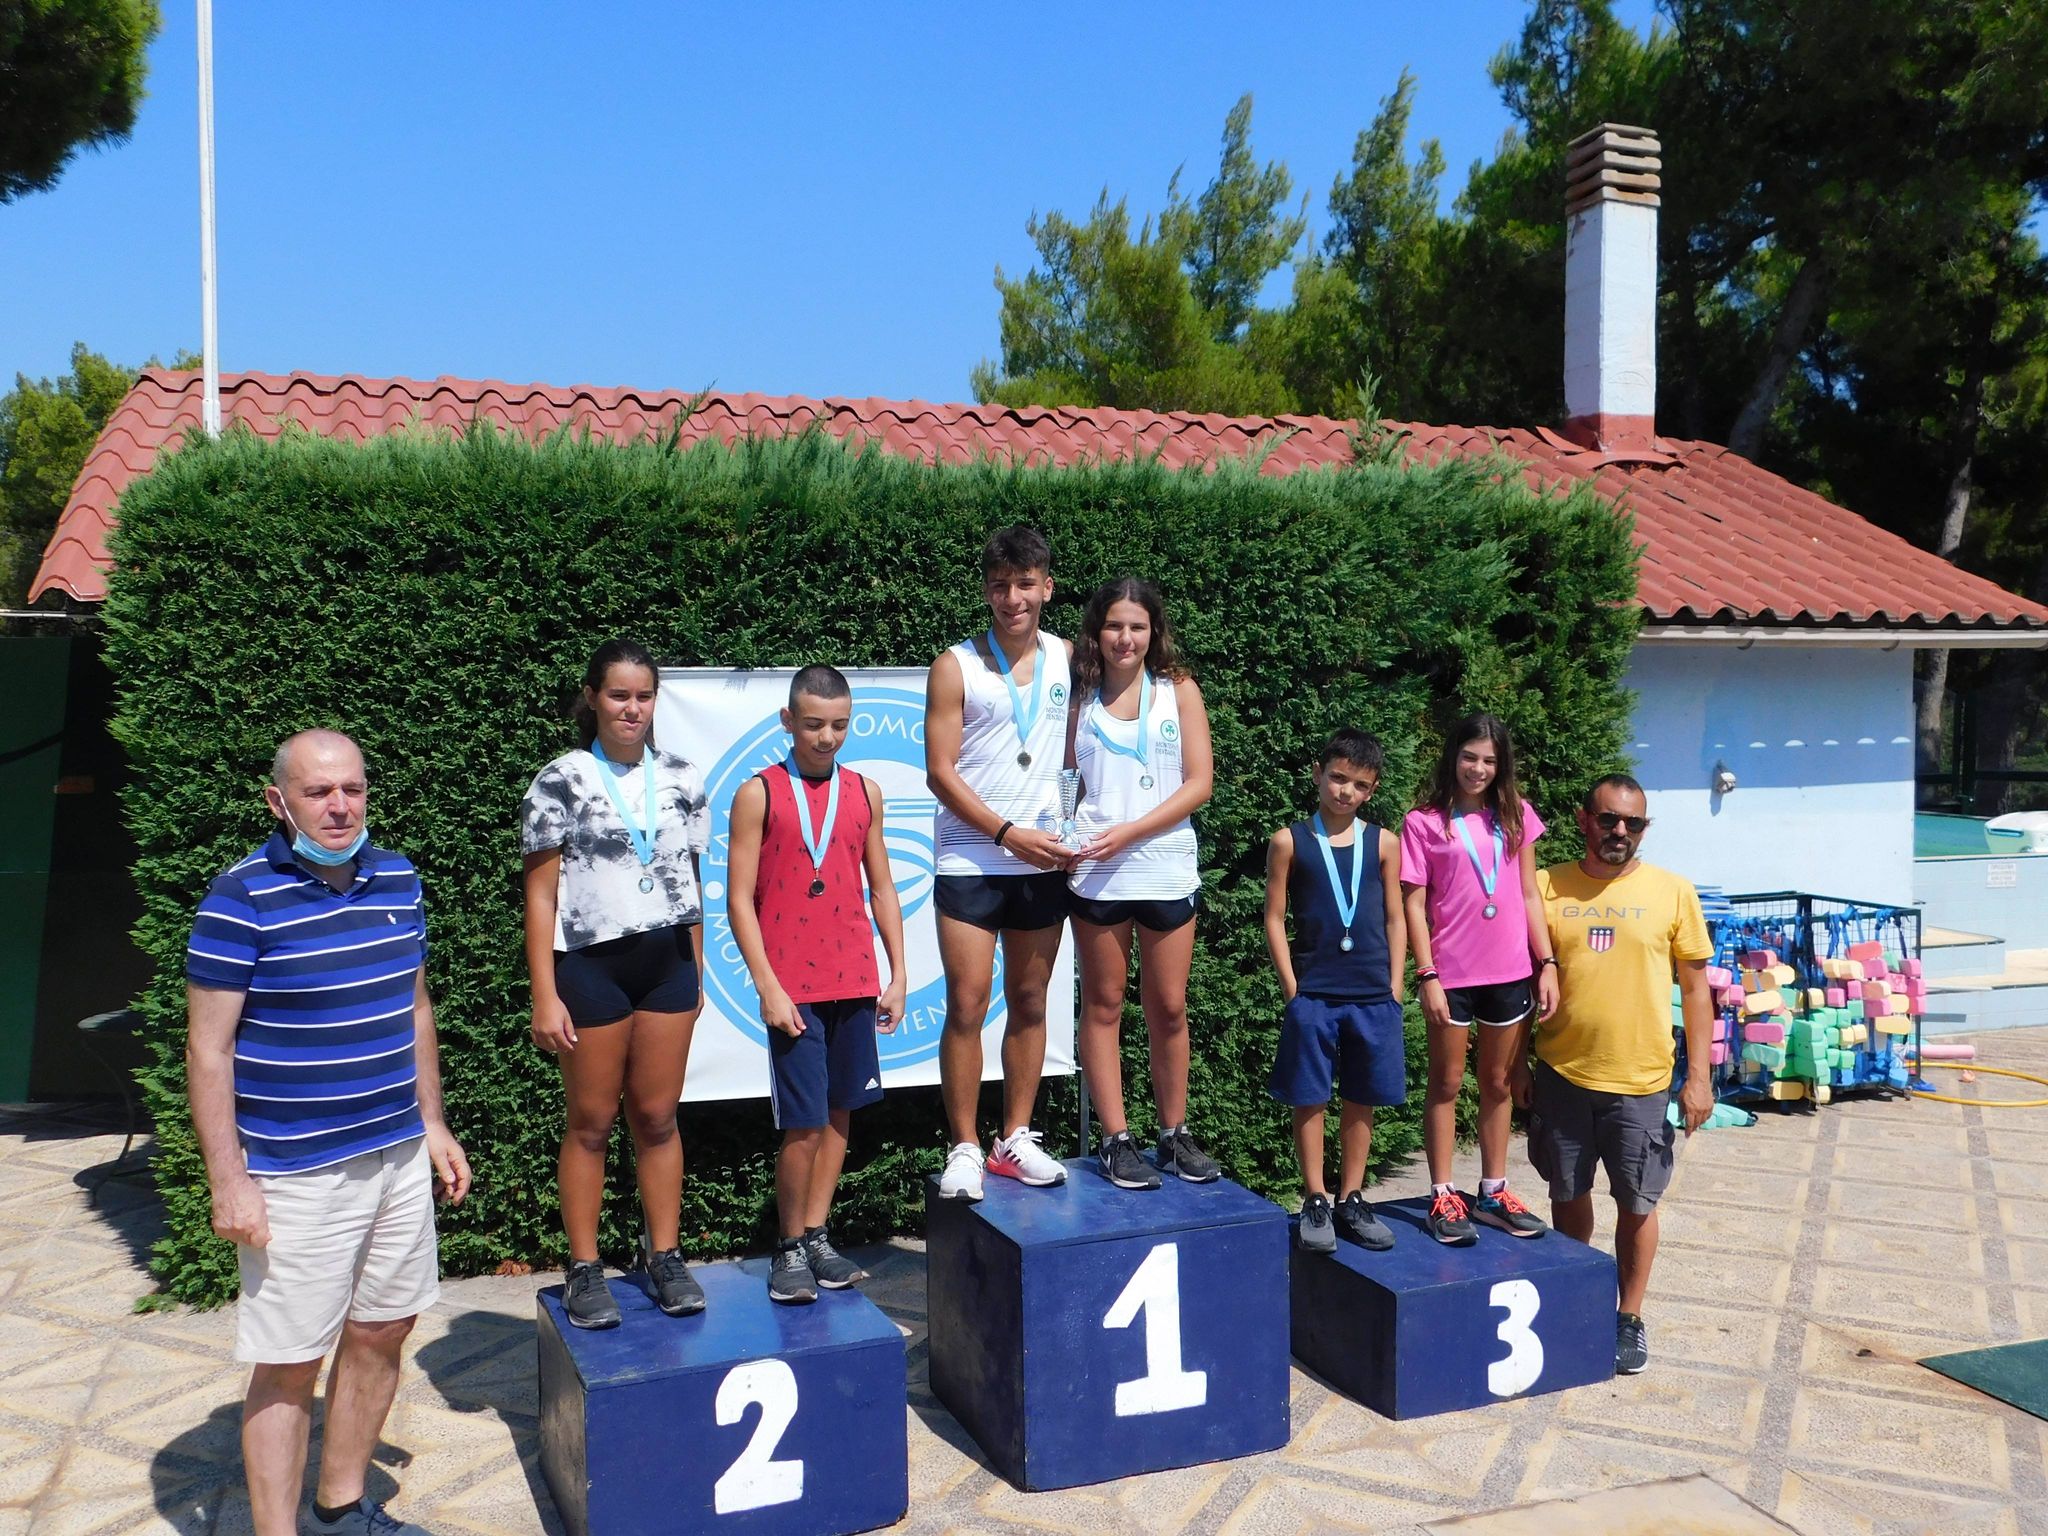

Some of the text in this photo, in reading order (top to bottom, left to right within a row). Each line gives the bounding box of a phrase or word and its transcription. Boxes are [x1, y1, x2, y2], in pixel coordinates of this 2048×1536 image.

[1562, 906, 1647, 919] GANT
[1103, 1242, 1207, 1417] 1
[1488, 1279, 1544, 1397] 3
[715, 1358, 804, 1515] 2
